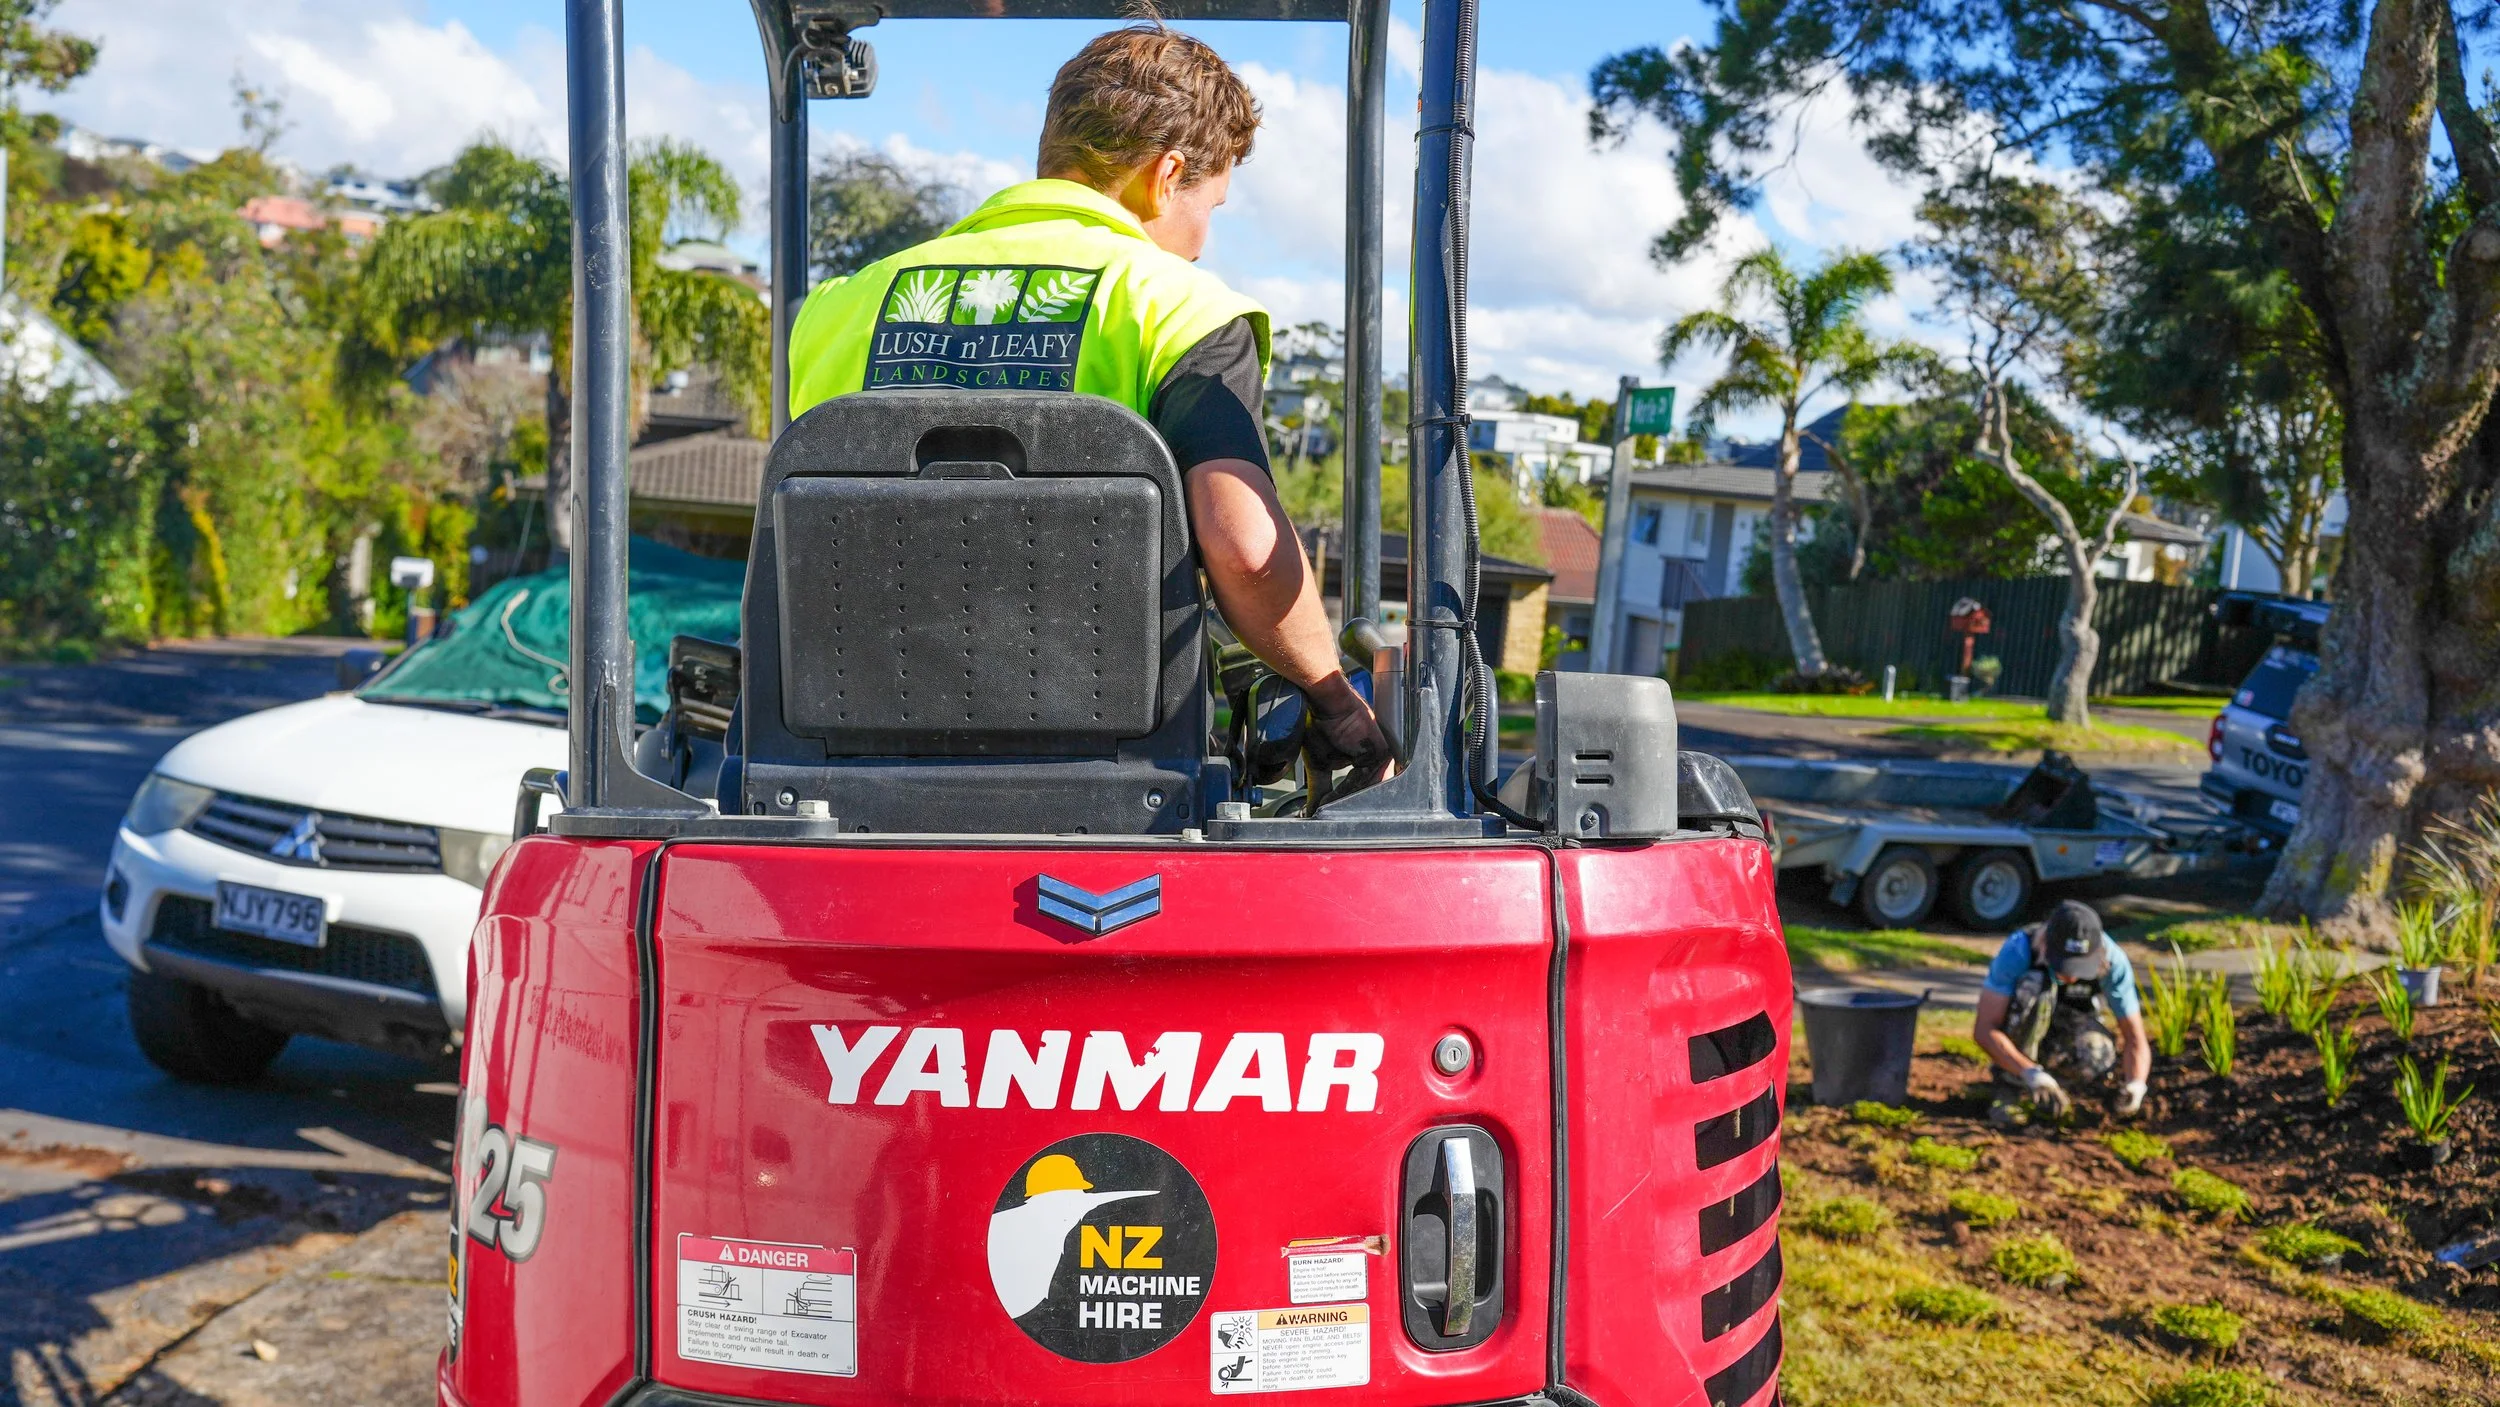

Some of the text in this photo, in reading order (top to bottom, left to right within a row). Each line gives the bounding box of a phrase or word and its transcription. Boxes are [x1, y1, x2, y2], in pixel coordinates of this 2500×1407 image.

[876, 332, 952, 356] LUSH
[988, 333, 1077, 359] LEAFY
[872, 365, 1071, 388] LANDSCAPES
[2241, 747, 2309, 788] TOYO
[221, 885, 319, 933] NJY796
[811, 1025, 1385, 1112] YANMAR
[739, 1247, 809, 1268] DANGER
[1080, 1225, 1163, 1269] NZ
[1079, 1275, 1200, 1296] MACHINE
[688, 1309, 756, 1324] CRUSH HAZARD!
[1079, 1301, 1162, 1329] HIRE
[1289, 1311, 1348, 1324] WARNING
[688, 1318, 701, 1328] Stay
[734, 1326, 754, 1335] swing
[757, 1329, 777, 1337] range
[791, 1330, 827, 1340] Excavator
[688, 1327, 724, 1338] implements
[744, 1336, 773, 1344] machine
[1280, 1326, 1346, 1337] SEVERE HAZARD!
[688, 1337, 709, 1346] Failure
[722, 1343, 746, 1352] comply
[798, 1350, 818, 1358] death
[688, 1347, 733, 1360] serious injury.
